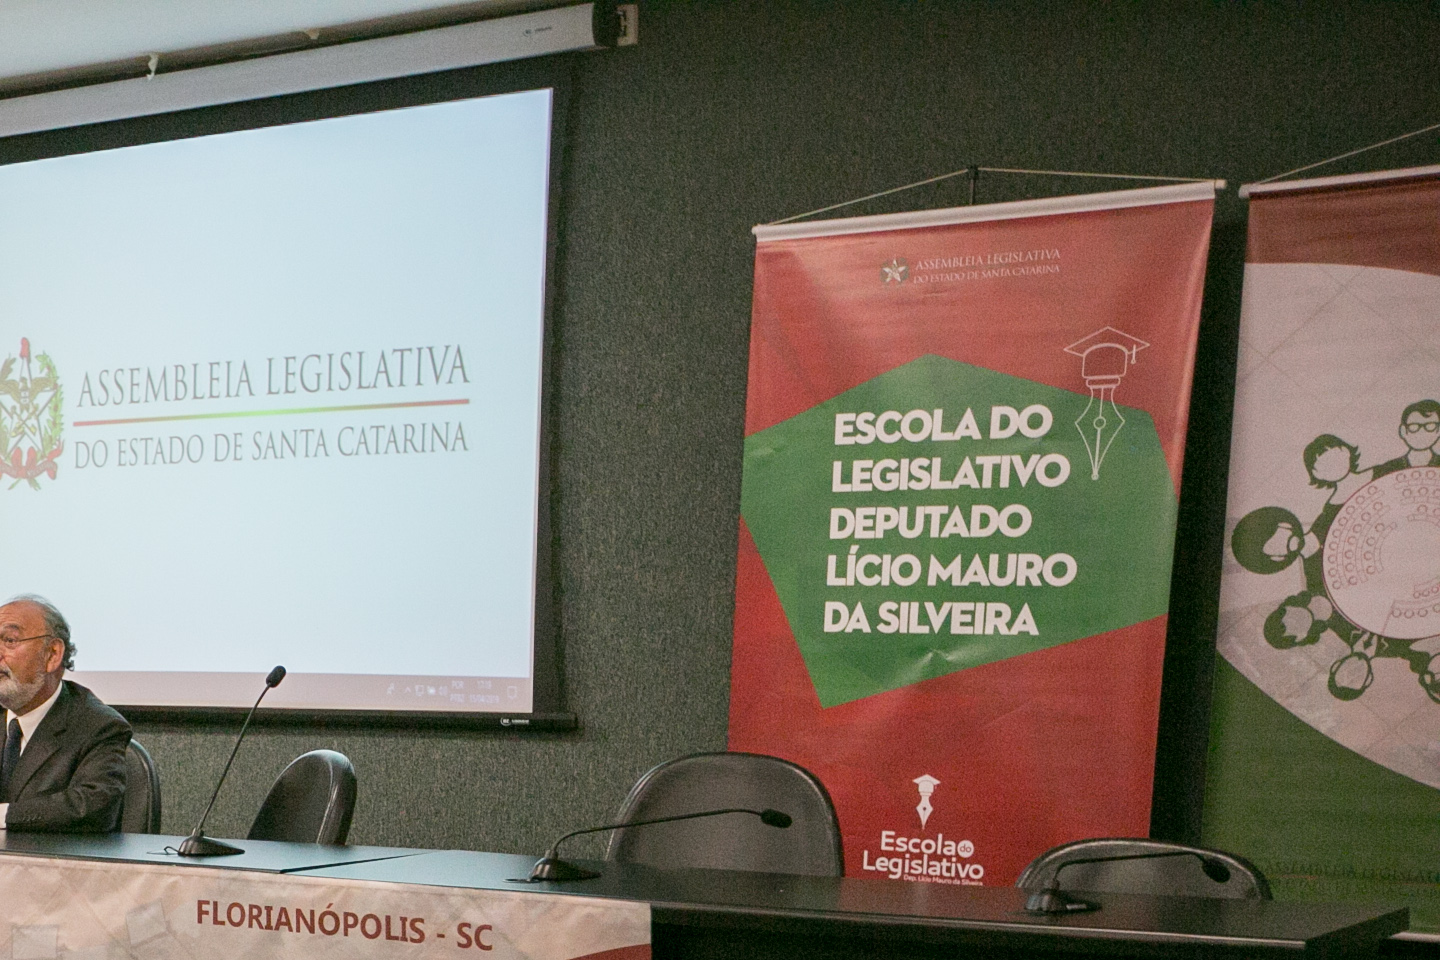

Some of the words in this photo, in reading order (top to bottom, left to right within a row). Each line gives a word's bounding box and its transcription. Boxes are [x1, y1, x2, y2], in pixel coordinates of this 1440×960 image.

[913, 274, 928, 284] DO
[930, 272, 965, 283] ESTADO
[967, 271, 979, 281] DE
[981, 268, 1011, 279] SANTA
[1012, 265, 1060, 277] CATARINA
[915, 255, 983, 270] ASSEMBLEIA
[987, 248, 1061, 265] LEGISLATIVA
[76, 359, 256, 408] ASSEMBLEIA
[265, 343, 470, 396] LEGISLATIVA
[834, 406, 982, 446] ESCOLA
[989, 404, 1053, 440] DO
[74, 439, 109, 469] DO
[116, 434, 205, 467] ESTADO
[213, 432, 243, 463] DE
[251, 427, 330, 461] SANTA
[336, 421, 469, 457] CATARINA
[831, 453, 1071, 493] LEGISLATIVO
[829, 503, 1033, 540] DEPUTADO
[826, 544, 922, 587] LÍCIO
[927, 552, 1078, 588] MAURO
[823, 600, 871, 634] DA
[876, 600, 1040, 636] SILVEIRA
[880, 830, 956, 856] Escola
[862, 849, 984, 880] Legislativo
[196, 899, 426, 944] FLORIANÓPOLIS
[456, 922, 494, 951] SC
